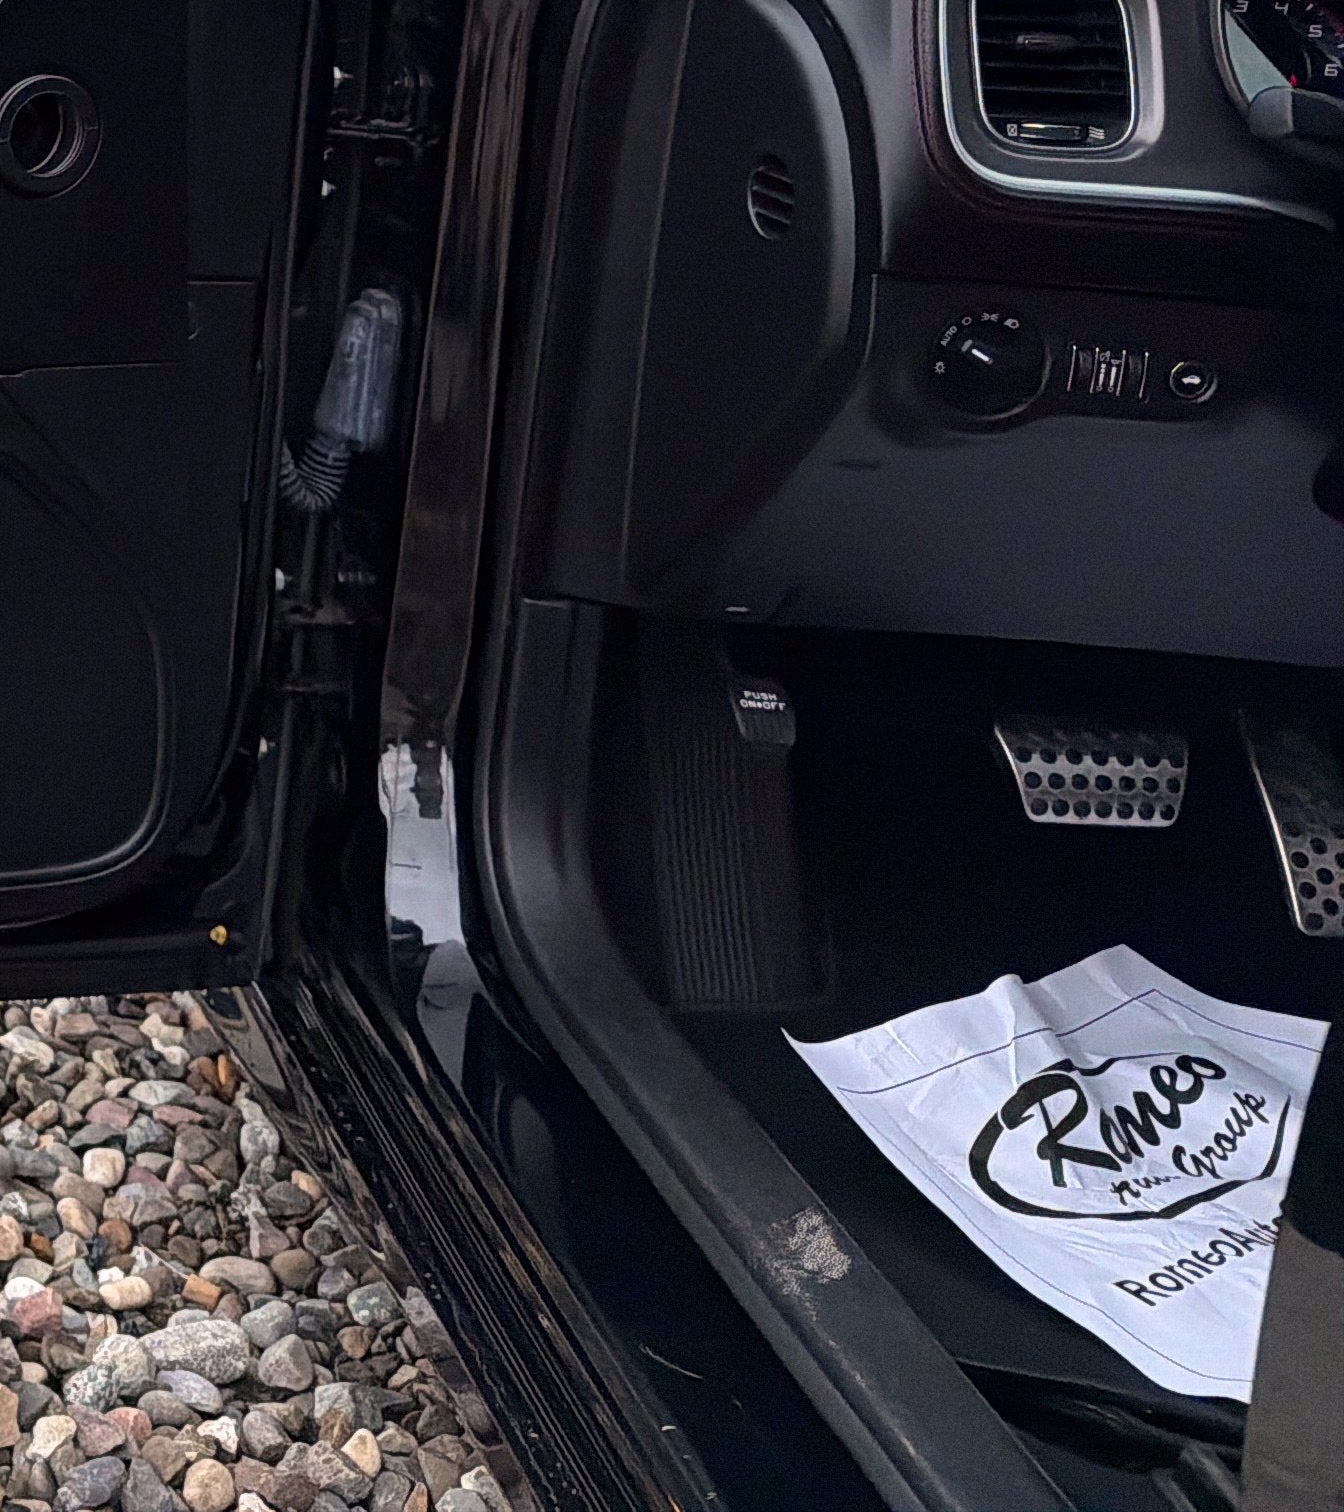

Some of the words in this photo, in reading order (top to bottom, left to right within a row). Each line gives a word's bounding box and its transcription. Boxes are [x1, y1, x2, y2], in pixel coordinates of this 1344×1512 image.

[1232, 0, 1249, 13] 3
[1274, 2, 1289, 16] 4
[1307, 24, 1323, 38] 5
[1324, 63, 1339, 77] 6
[940, 325, 958, 347] AUTO
[743, 690, 778, 701] PUSH
[1171, 1090, 1271, 1180] Group
